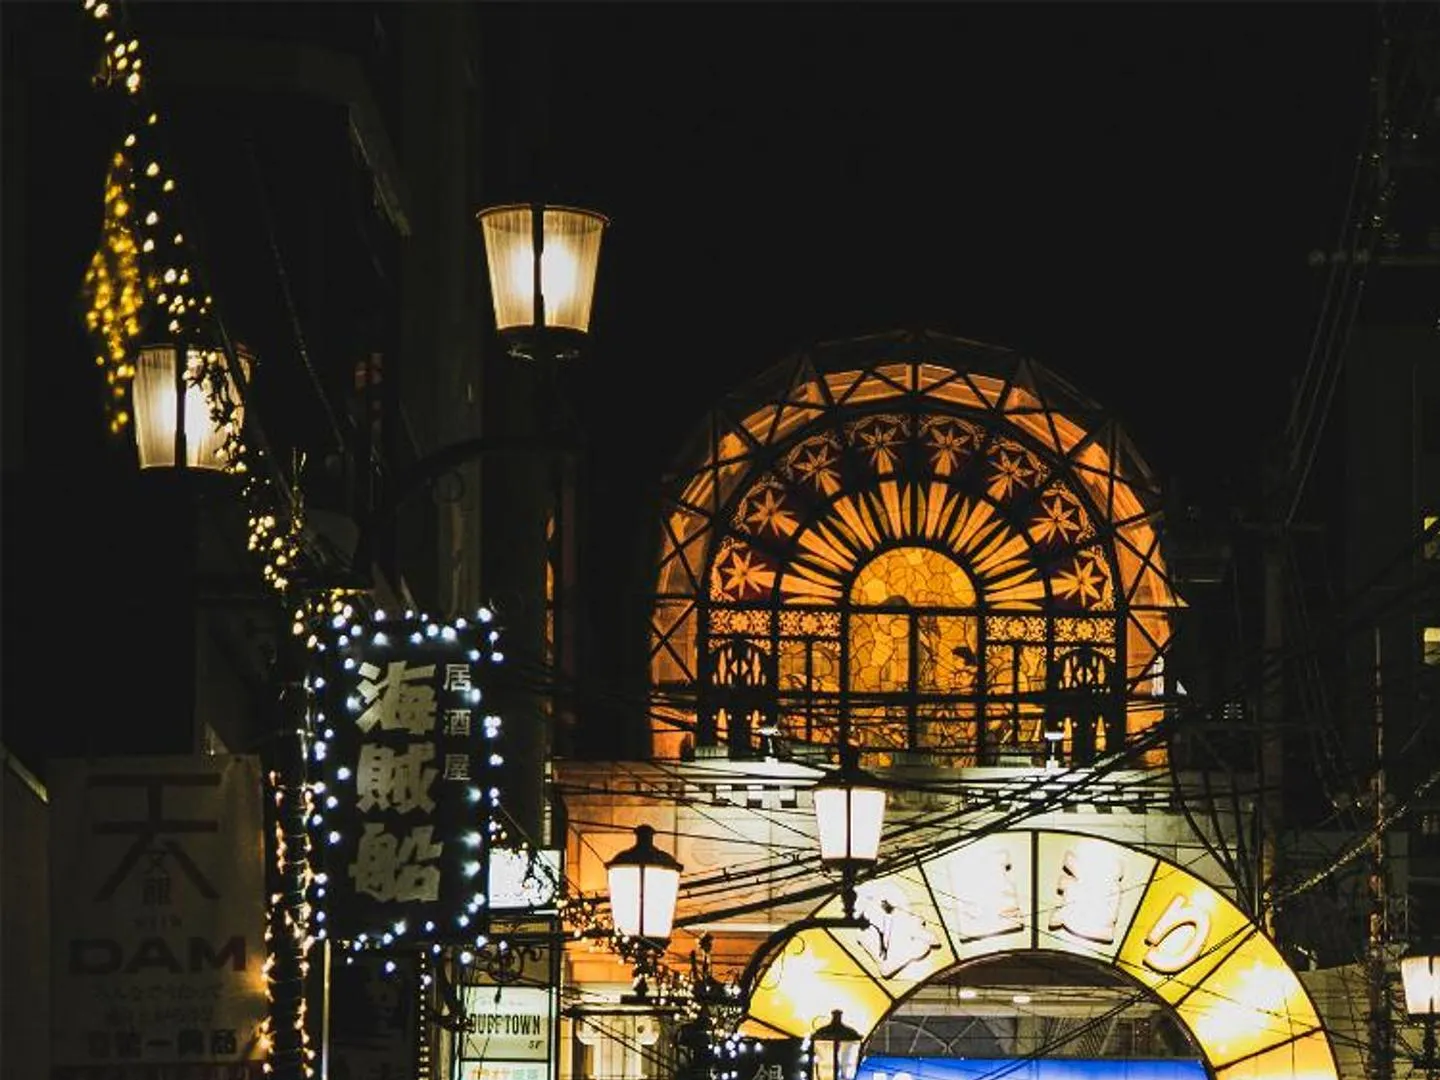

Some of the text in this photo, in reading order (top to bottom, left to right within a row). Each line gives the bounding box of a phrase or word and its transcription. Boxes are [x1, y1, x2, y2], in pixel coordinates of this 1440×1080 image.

[348, 659, 444, 903] 海賊船
[443, 662, 473, 783] 居酒屋
[68, 936, 247, 976] DAM
